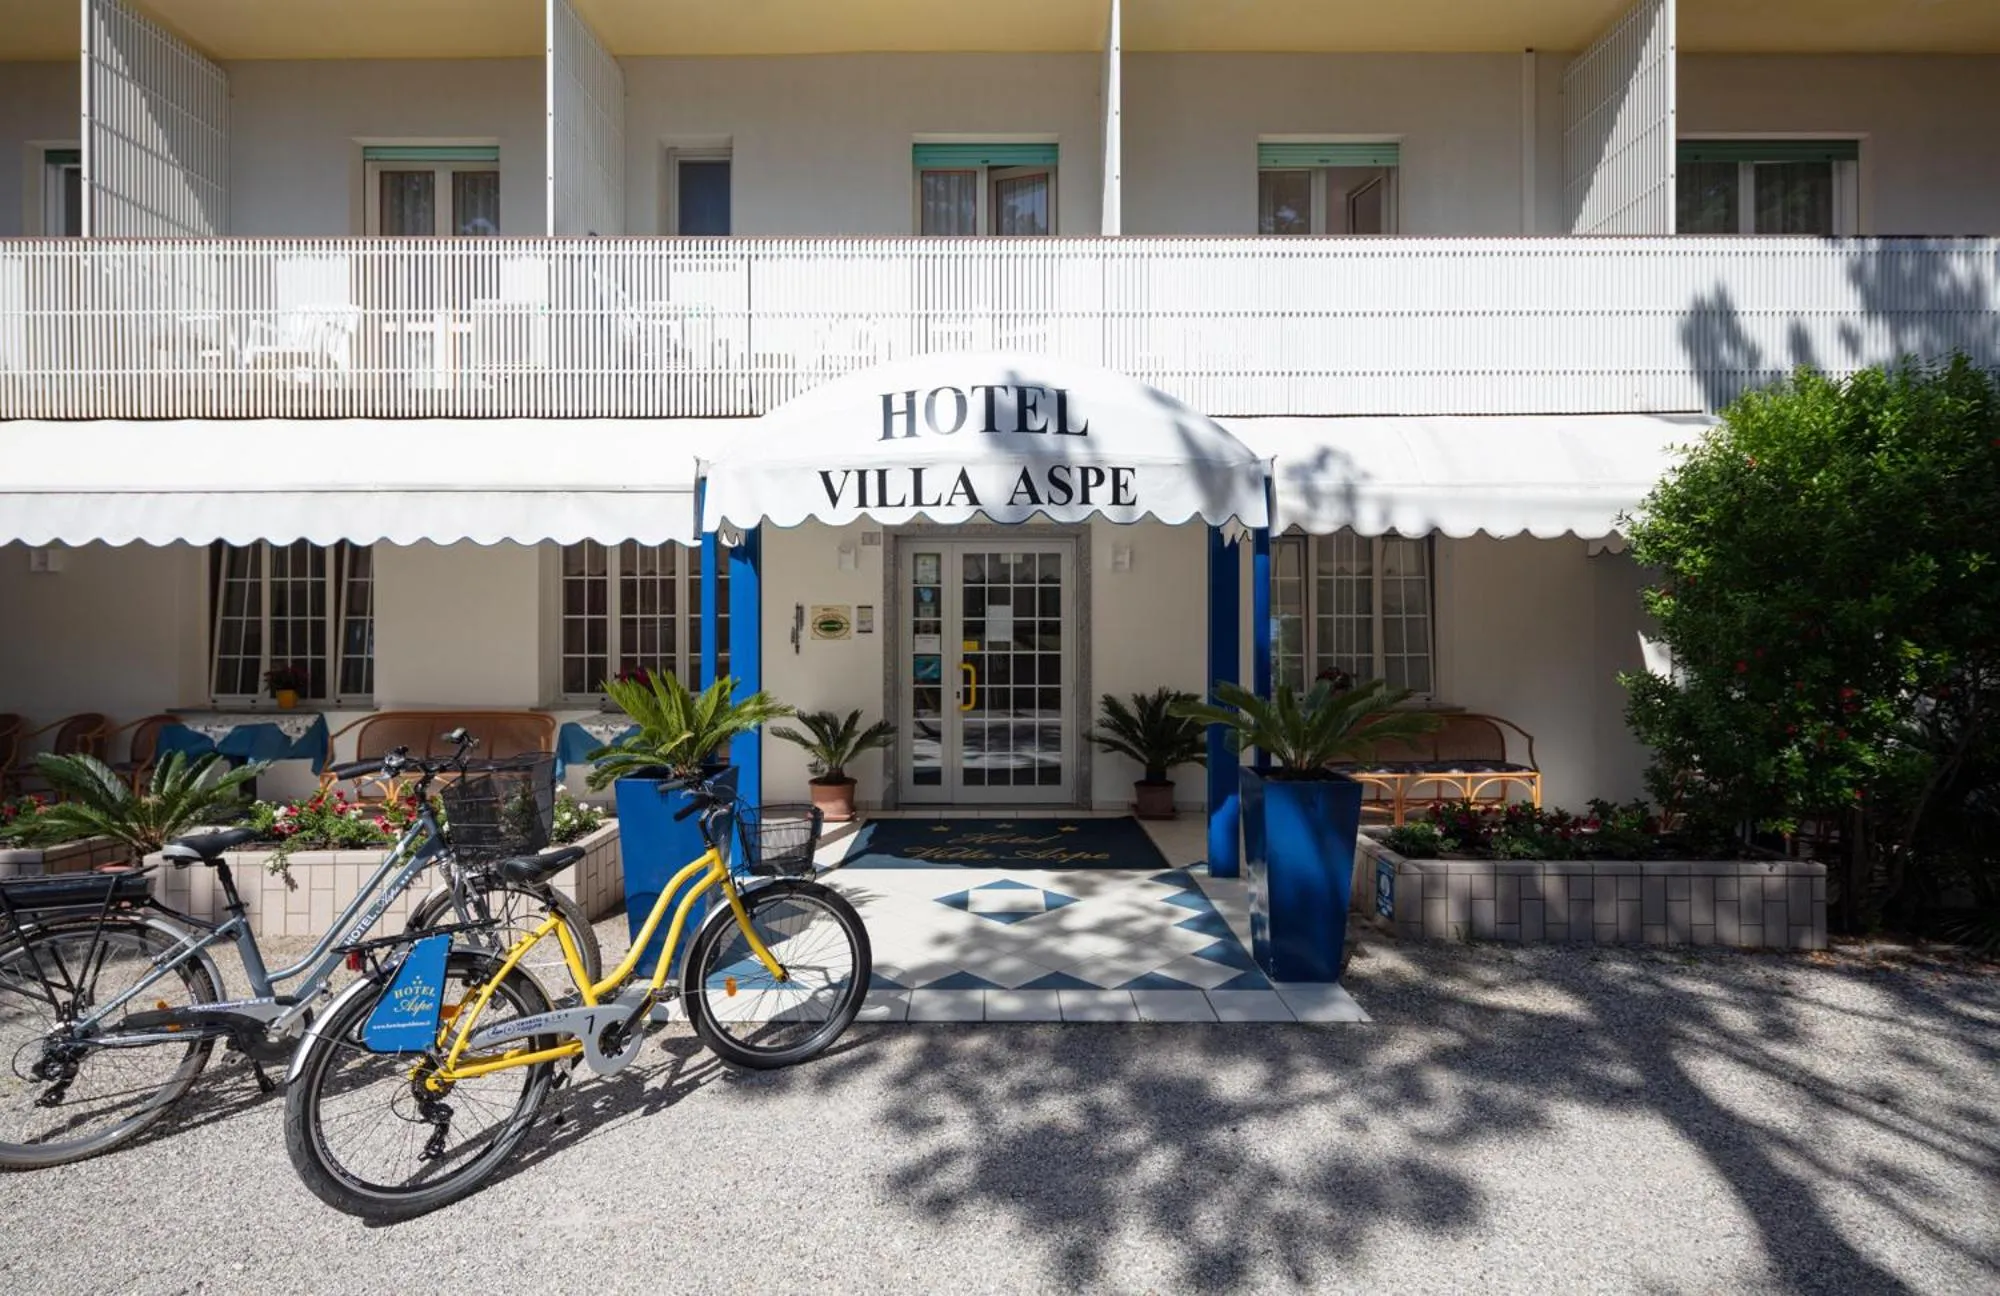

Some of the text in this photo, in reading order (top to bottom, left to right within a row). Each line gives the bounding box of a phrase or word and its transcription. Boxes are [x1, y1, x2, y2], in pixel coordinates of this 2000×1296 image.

[877, 384, 1089, 442] HOTEL
[817, 464, 1138, 510] VILLA ASPE
[343, 912, 378, 946] HOTEL
[393, 995, 434, 1017] Aspe
[394, 985, 436, 999] HOTEL
